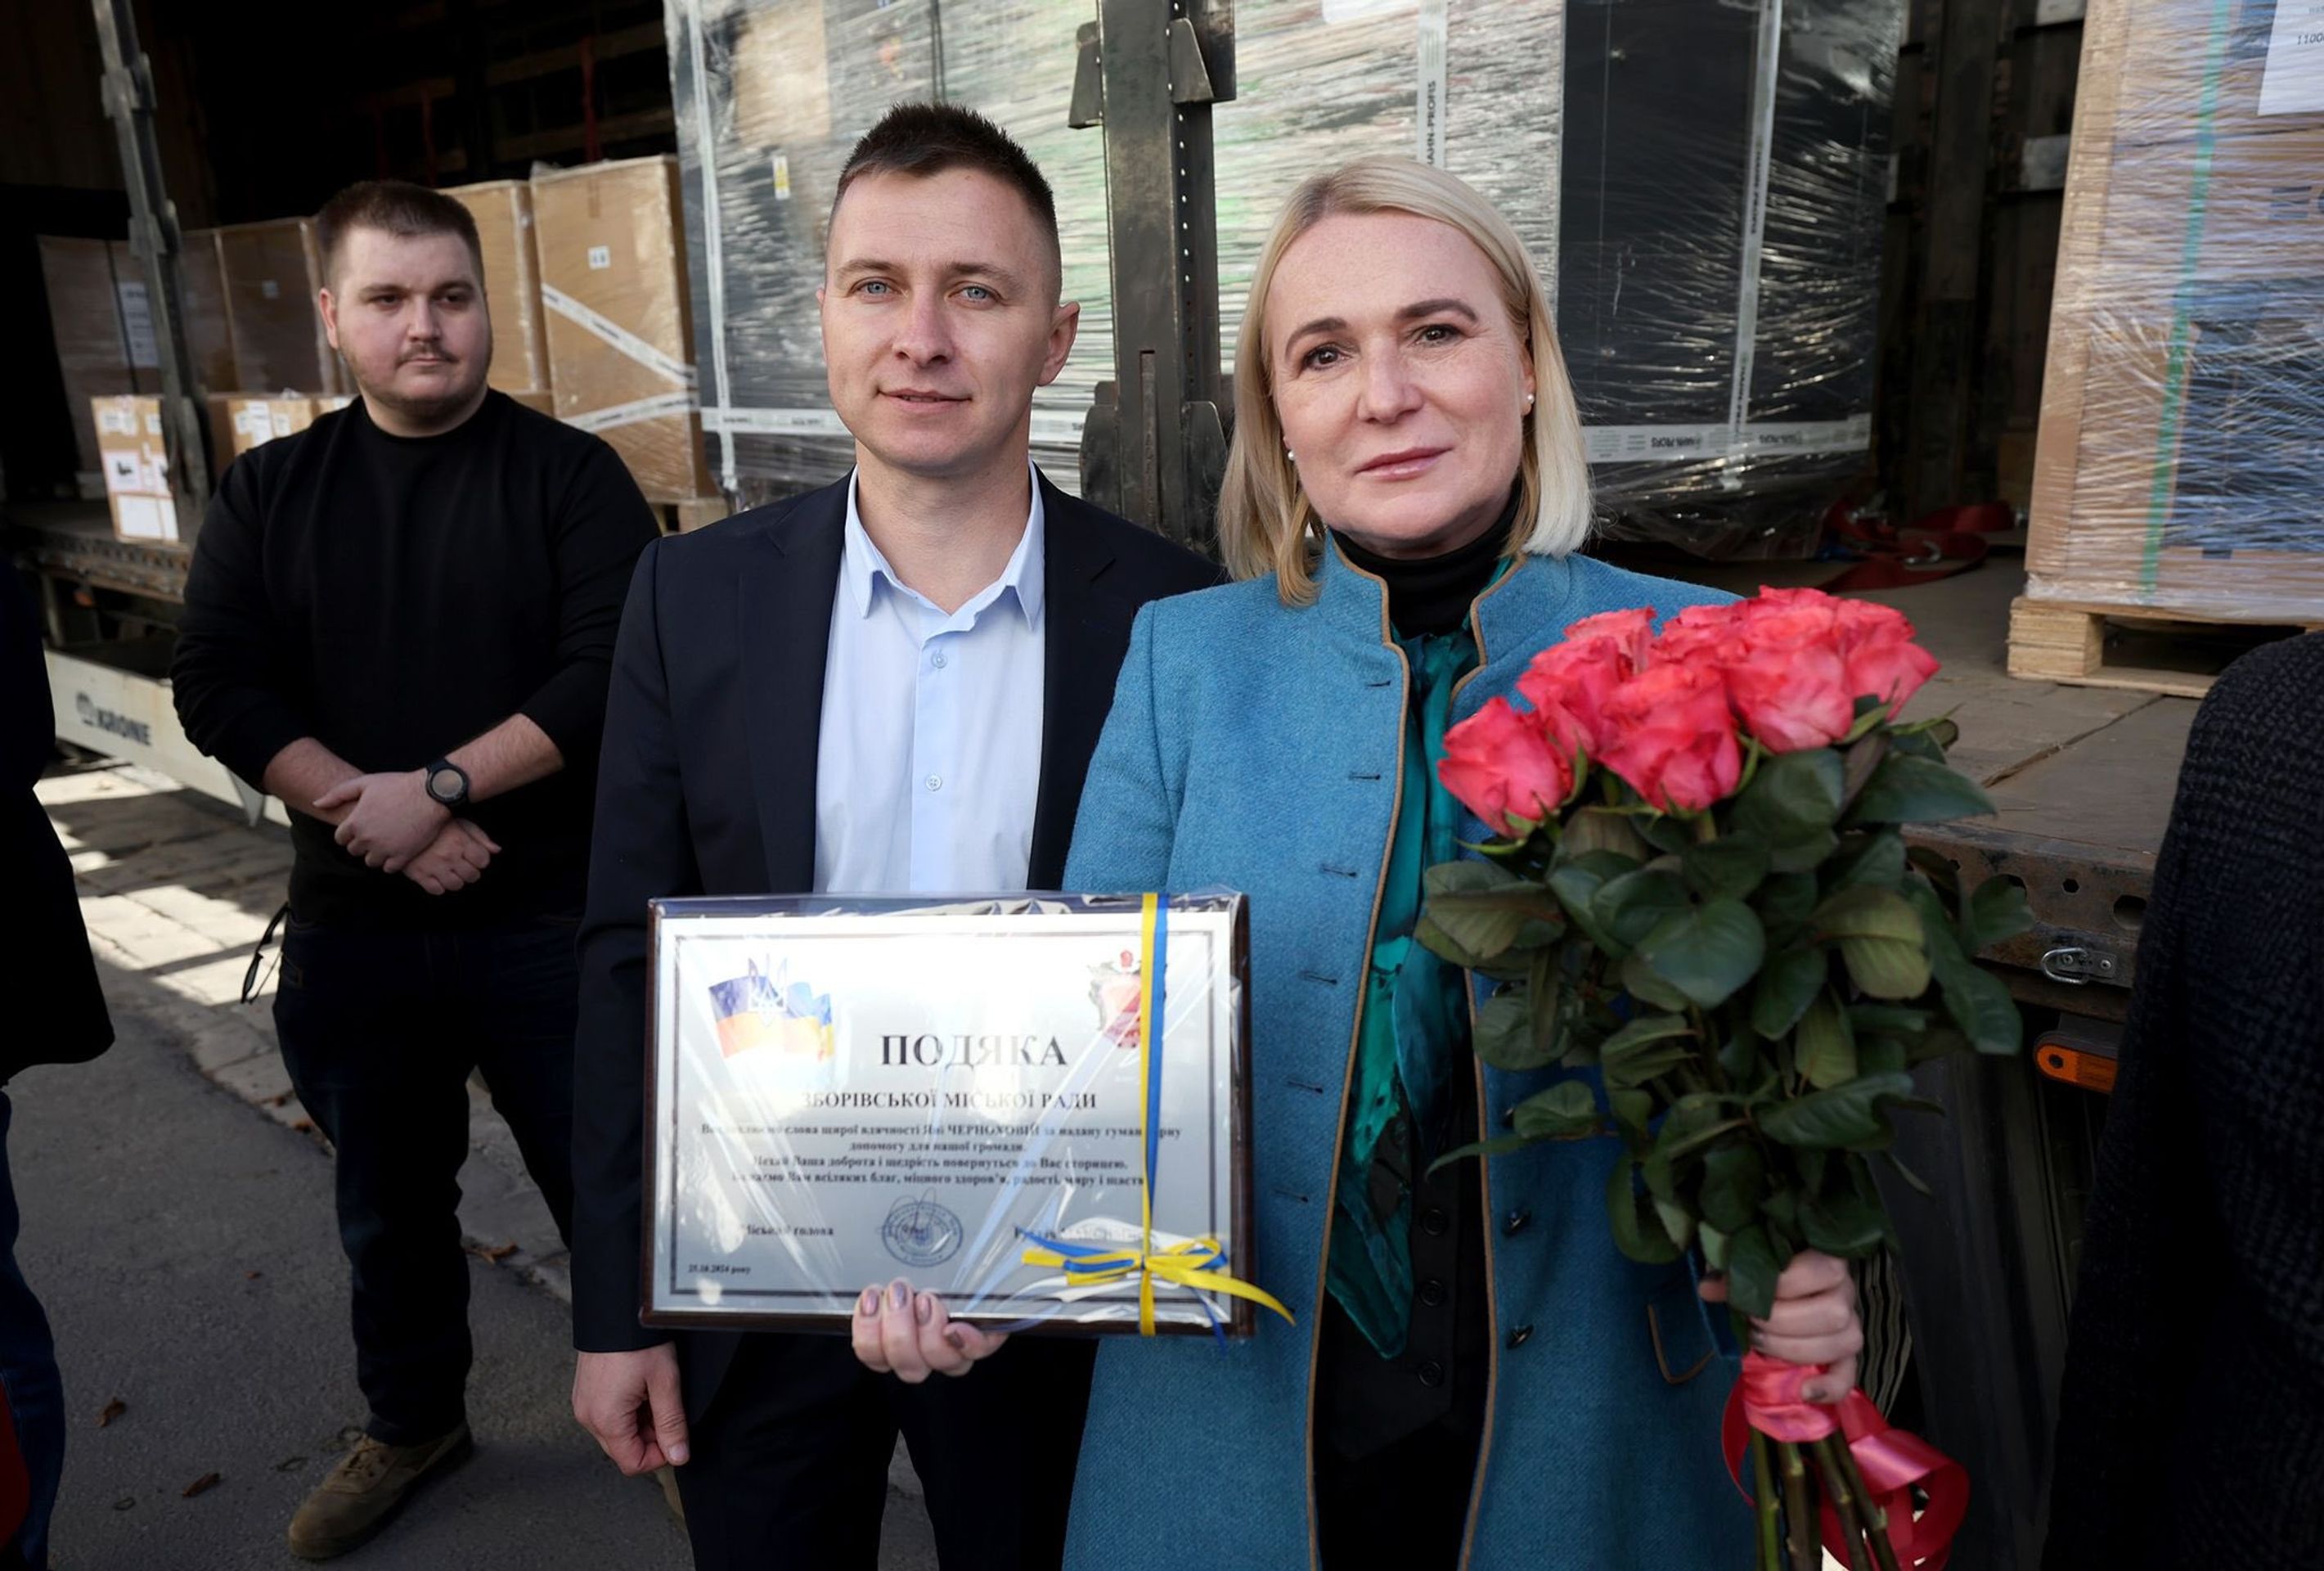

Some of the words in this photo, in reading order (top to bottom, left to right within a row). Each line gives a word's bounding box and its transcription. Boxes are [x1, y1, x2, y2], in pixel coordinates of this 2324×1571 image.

[881, 1033, 1068, 1072] ПОДЯКА
[801, 1088, 937, 1108] ЗБОРІВСЬКОЇ
[944, 1088, 1034, 1109] МІСЬКОЇ
[1041, 1092, 1097, 1110] РАДИ
